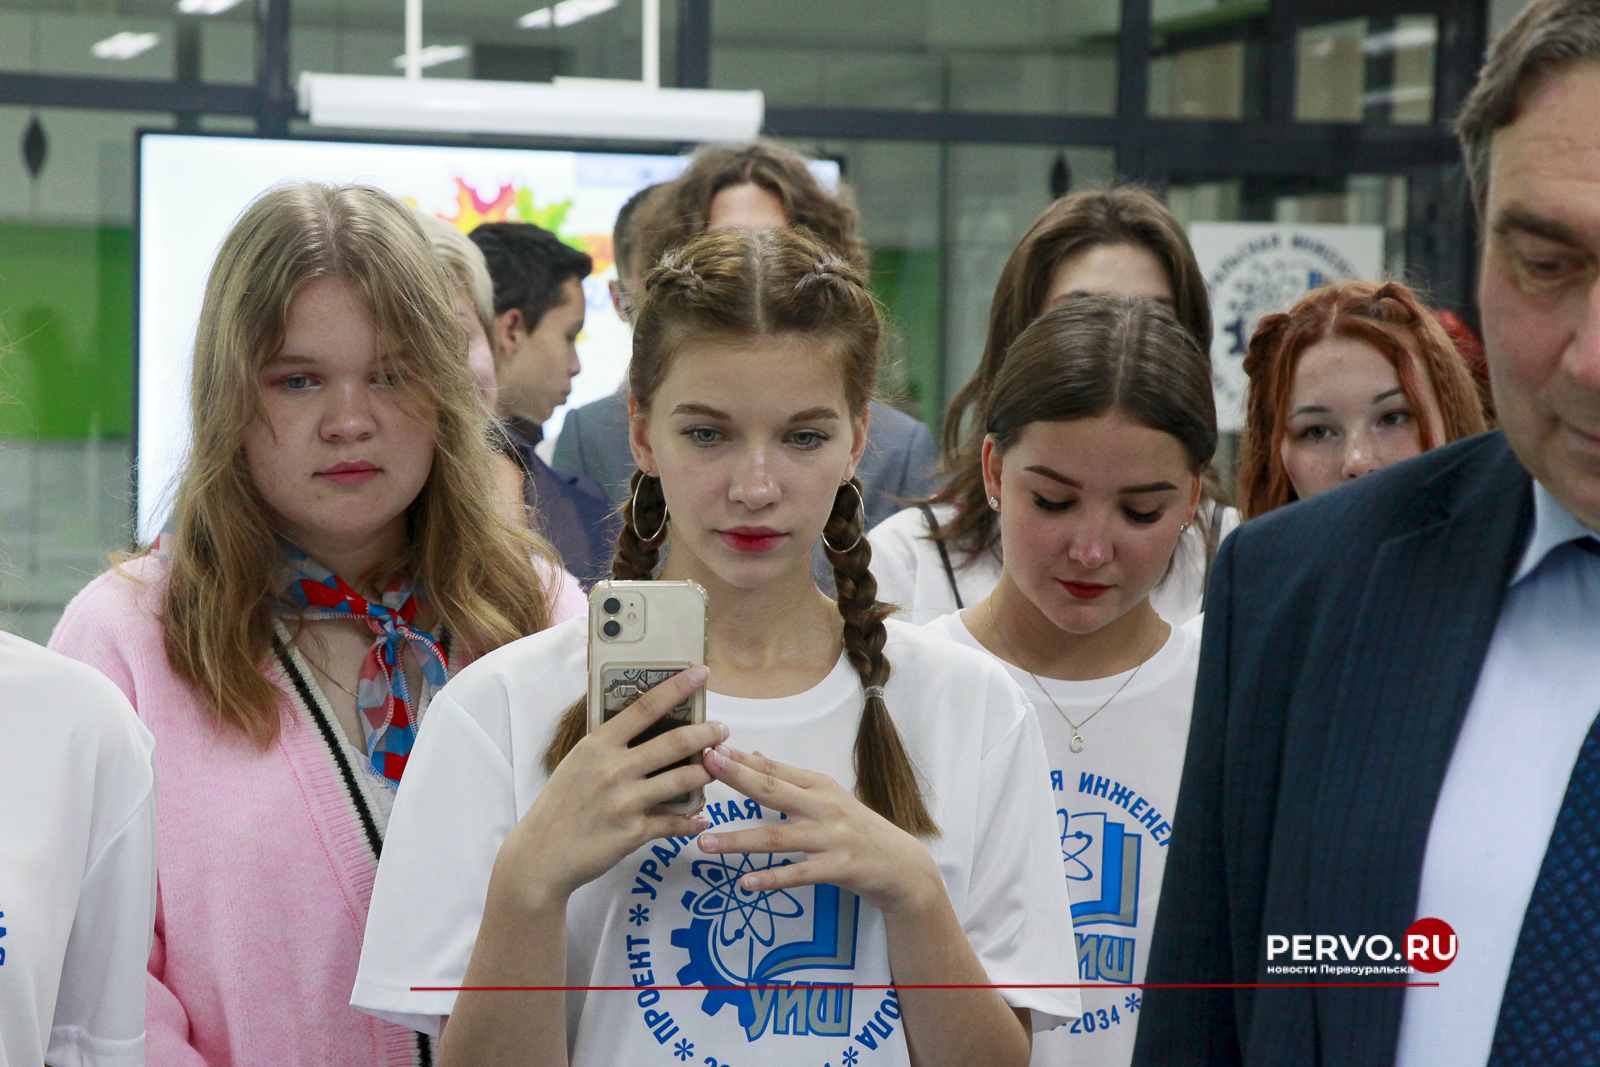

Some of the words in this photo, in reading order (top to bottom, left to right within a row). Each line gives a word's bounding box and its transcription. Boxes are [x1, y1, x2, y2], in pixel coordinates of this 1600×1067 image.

[631, 799, 763, 900] УРАЛКАЯ
[626, 934, 681, 1046] ПРОЕКТ
[1074, 933, 1136, 985] ИШ
[854, 980, 901, 1051] ОЛА
[1063, 1004, 1121, 1034] 2034
